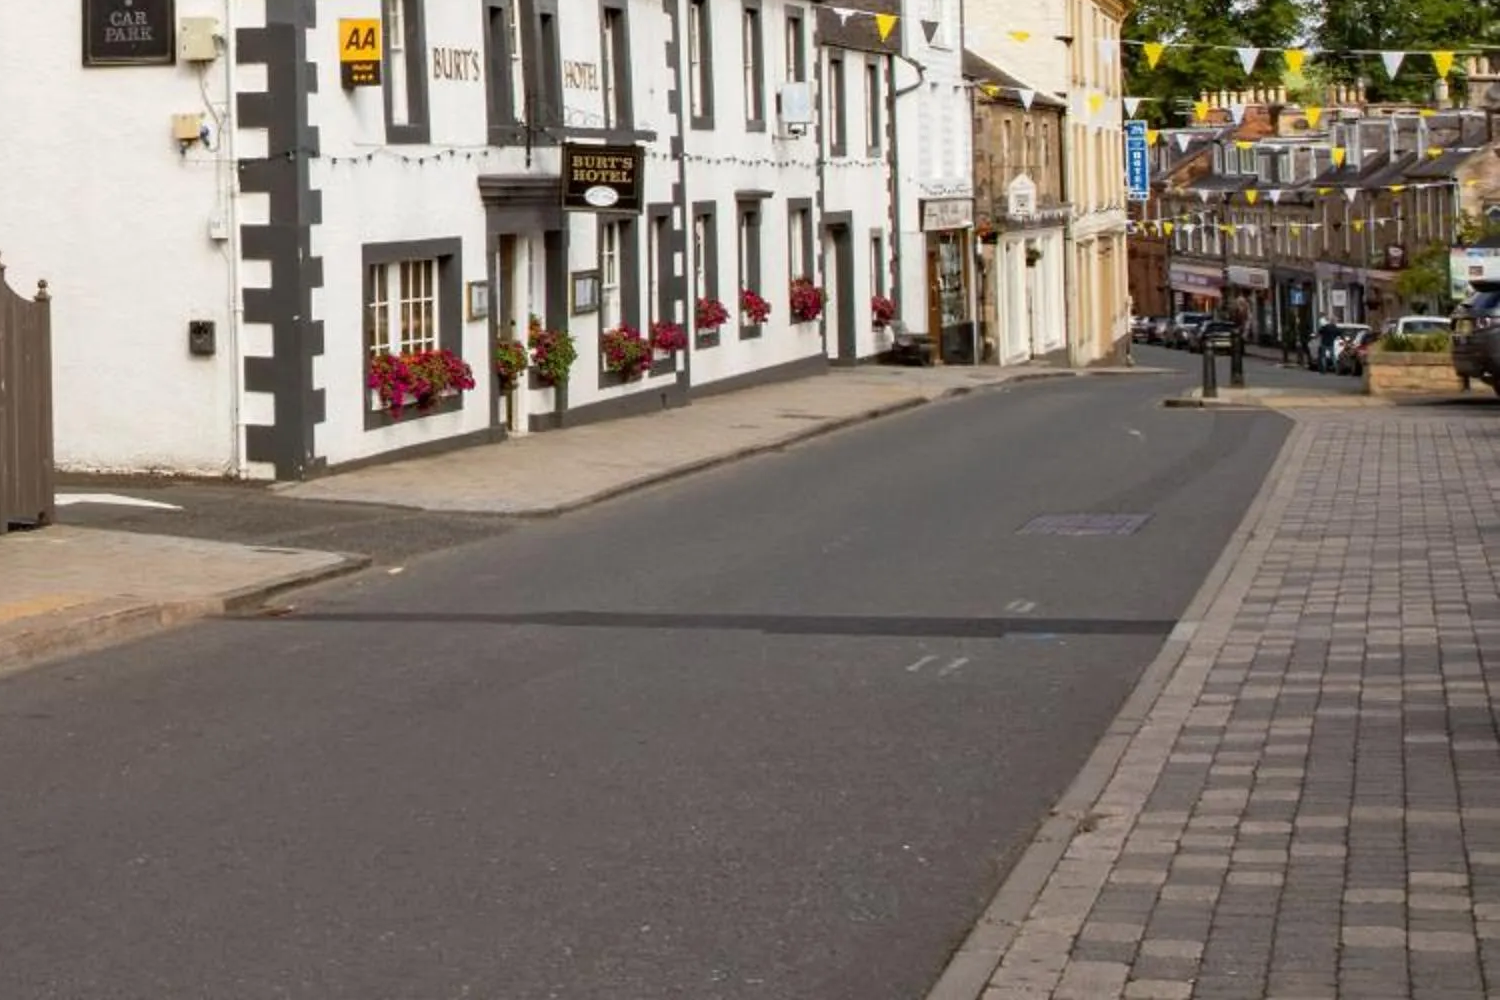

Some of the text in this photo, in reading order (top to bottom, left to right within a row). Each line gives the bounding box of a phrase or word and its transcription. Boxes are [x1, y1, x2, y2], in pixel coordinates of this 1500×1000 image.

[109, 10, 148, 27] CAR
[104, 25, 154, 43] PARK
[346, 27, 376, 51] AA
[432, 47, 599, 91] BURT'S HOTEL
[572, 168, 633, 184] HOTEL
